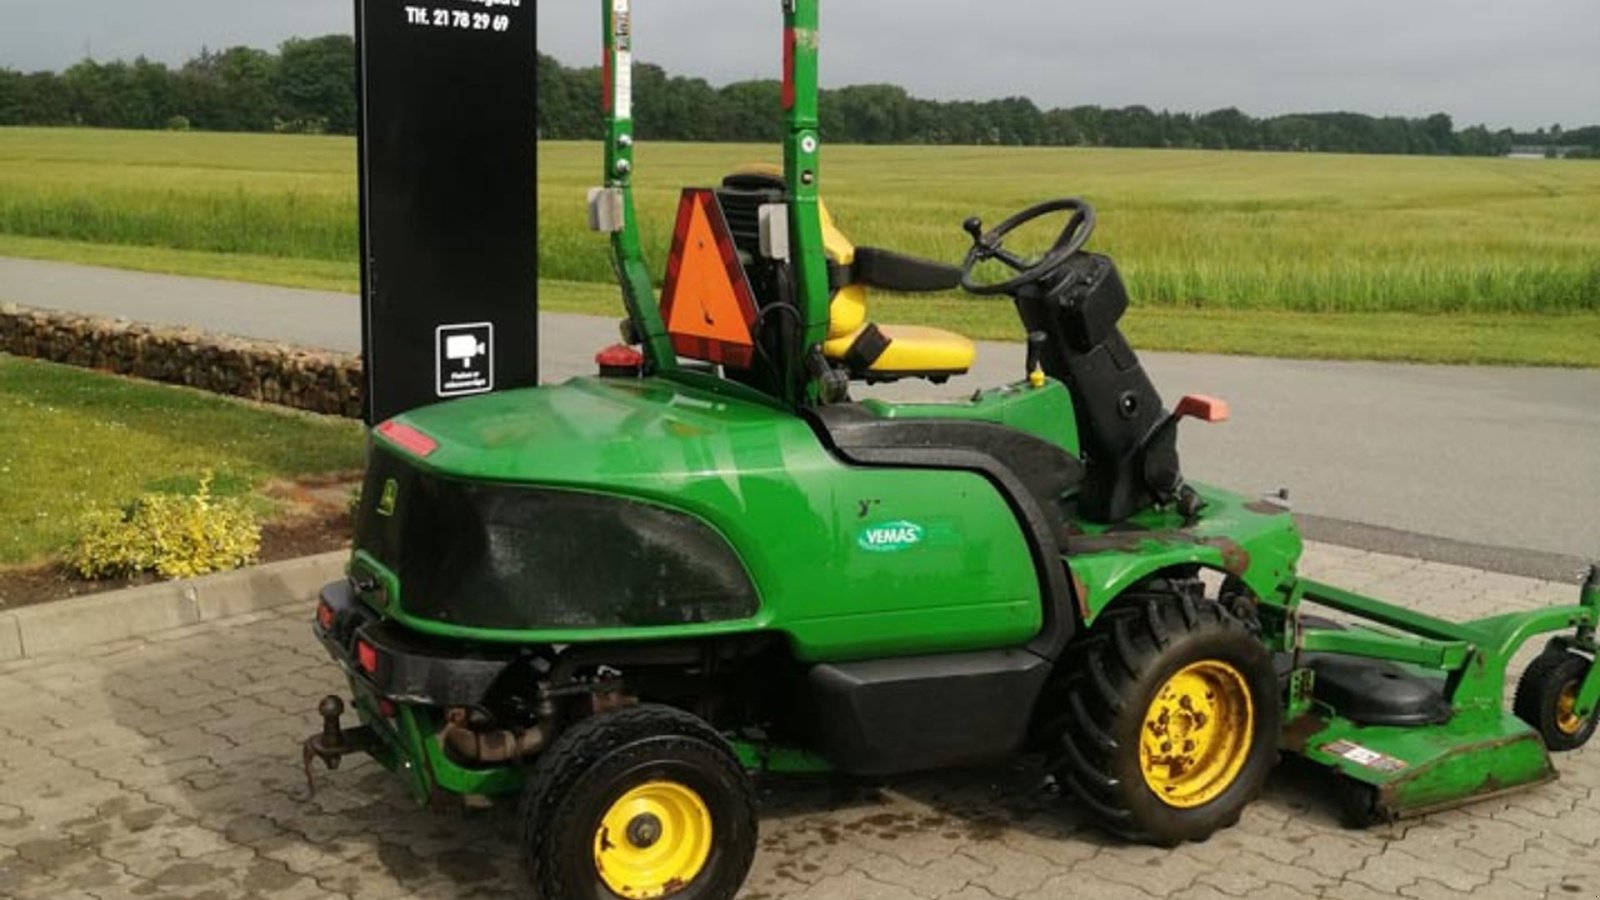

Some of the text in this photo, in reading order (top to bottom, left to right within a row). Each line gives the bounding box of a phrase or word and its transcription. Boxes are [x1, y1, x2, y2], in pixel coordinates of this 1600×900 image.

[405, 6, 509, 32] Tlf. 21 78 29 69
[866, 528, 919, 544] VEMAS
